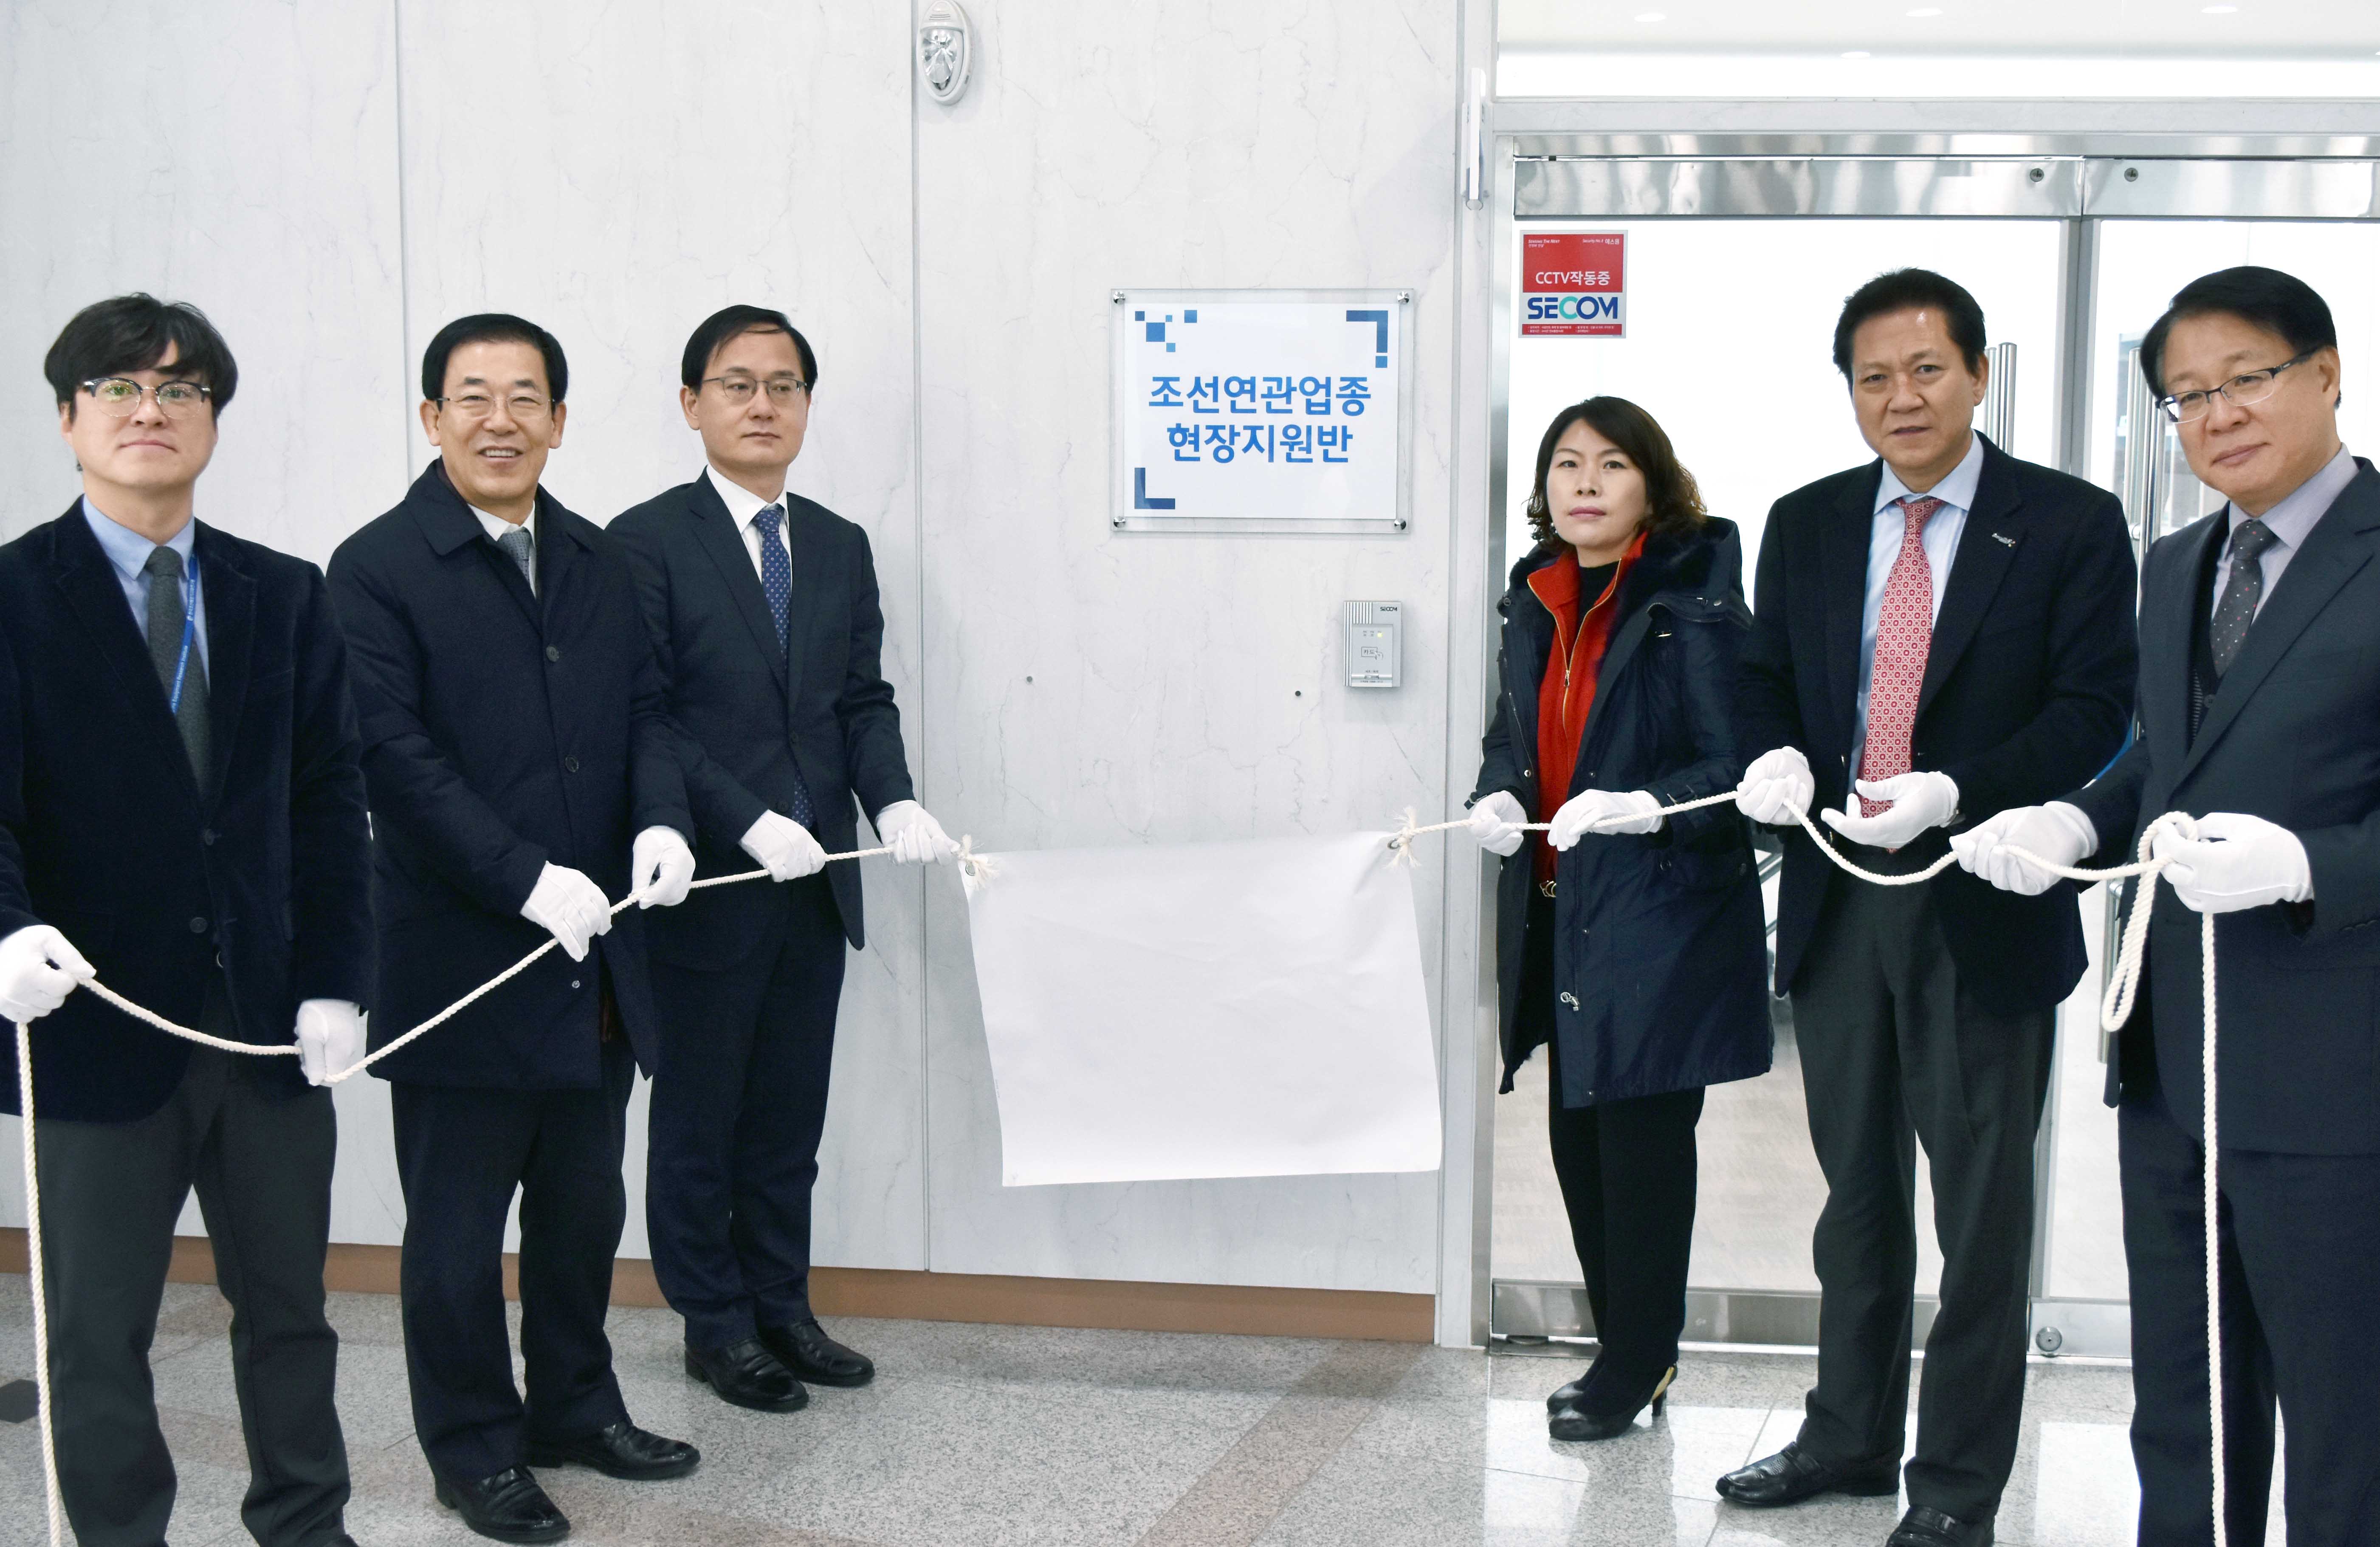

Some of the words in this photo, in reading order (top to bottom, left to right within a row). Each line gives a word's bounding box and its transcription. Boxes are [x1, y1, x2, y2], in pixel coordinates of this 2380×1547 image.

[1535, 271, 1610, 285] CCTV작동중
[1527, 296, 1618, 320] SECOM
[1148, 376, 1371, 416] 조선연관업종
[1167, 423, 1353, 463] 현장지원반
